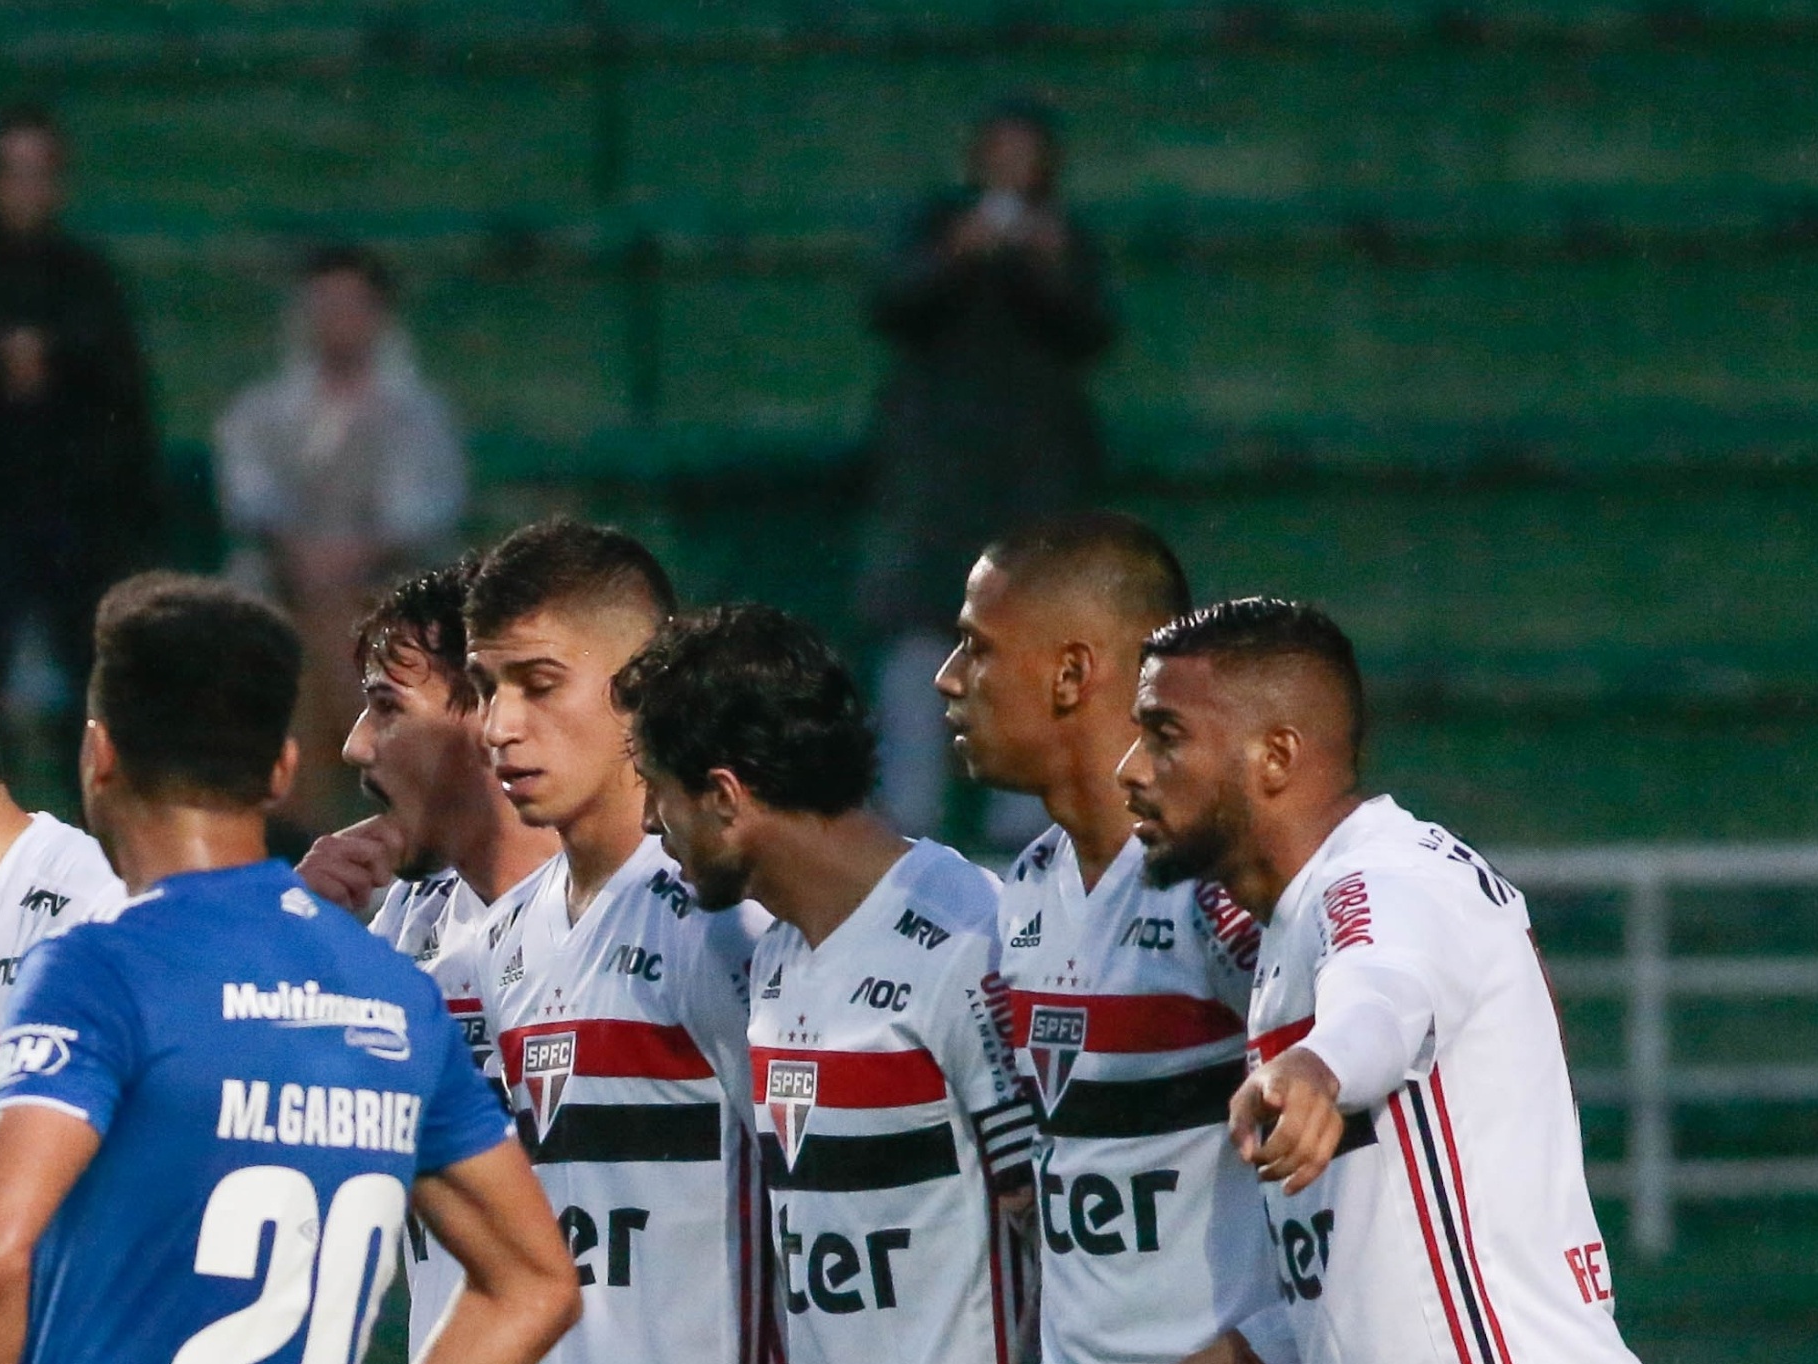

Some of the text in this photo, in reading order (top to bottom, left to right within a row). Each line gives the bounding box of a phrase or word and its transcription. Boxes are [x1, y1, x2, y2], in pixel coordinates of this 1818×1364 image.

[894, 908, 952, 950] MRV
[527, 1038, 571, 1070] SPFC
[771, 1071, 813, 1095] SPFC
[1039, 1144, 1180, 1256] ter
